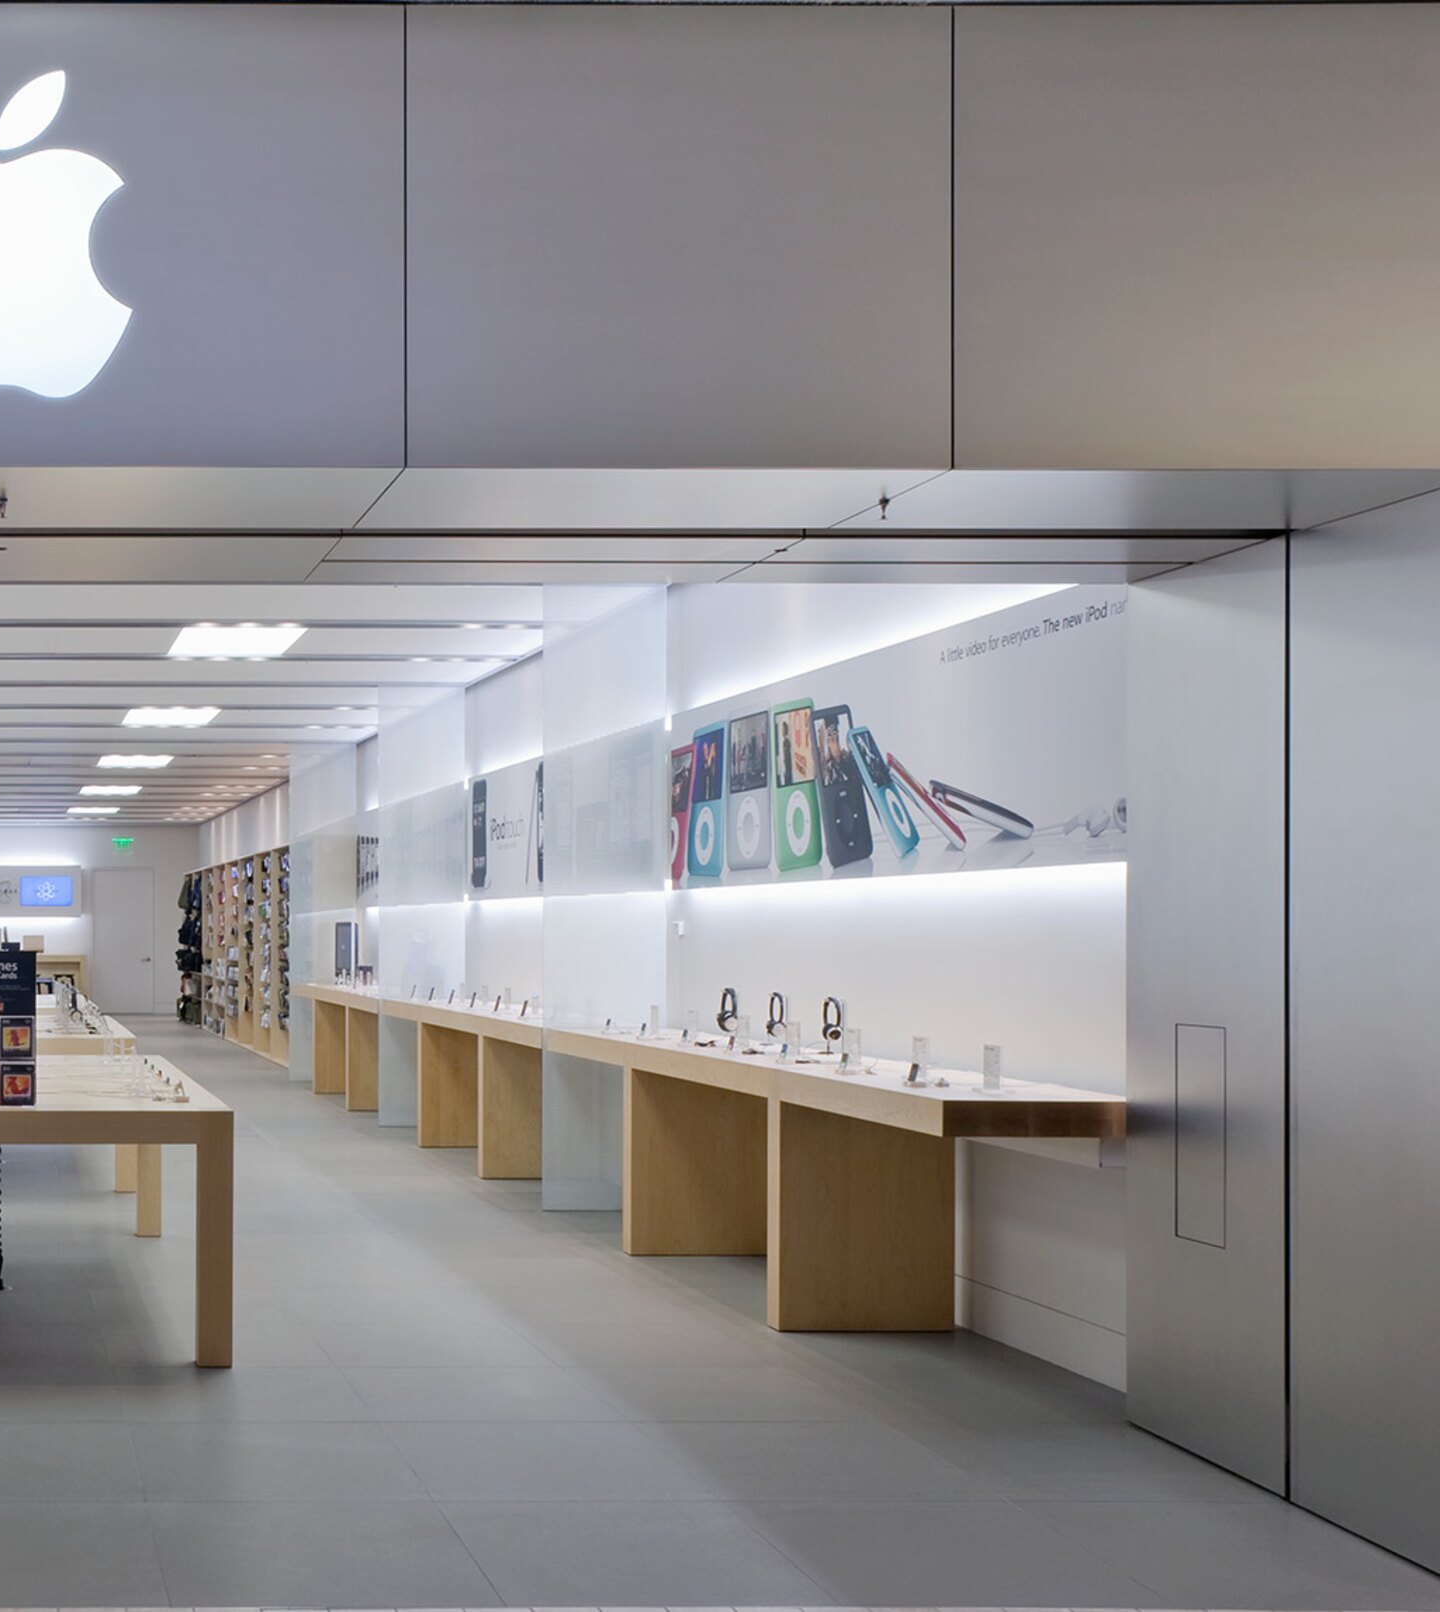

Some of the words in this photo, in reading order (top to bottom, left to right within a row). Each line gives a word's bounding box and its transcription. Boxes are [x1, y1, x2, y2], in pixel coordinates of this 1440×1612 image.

[940, 651, 946, 664] A
[947, 646, 963, 662] little
[965, 640, 987, 657] video
[988, 634, 1000, 651] for
[1043, 618, 1060, 635] The
[1062, 613, 1083, 630] new
[1085, 601, 1108, 623] iPod
